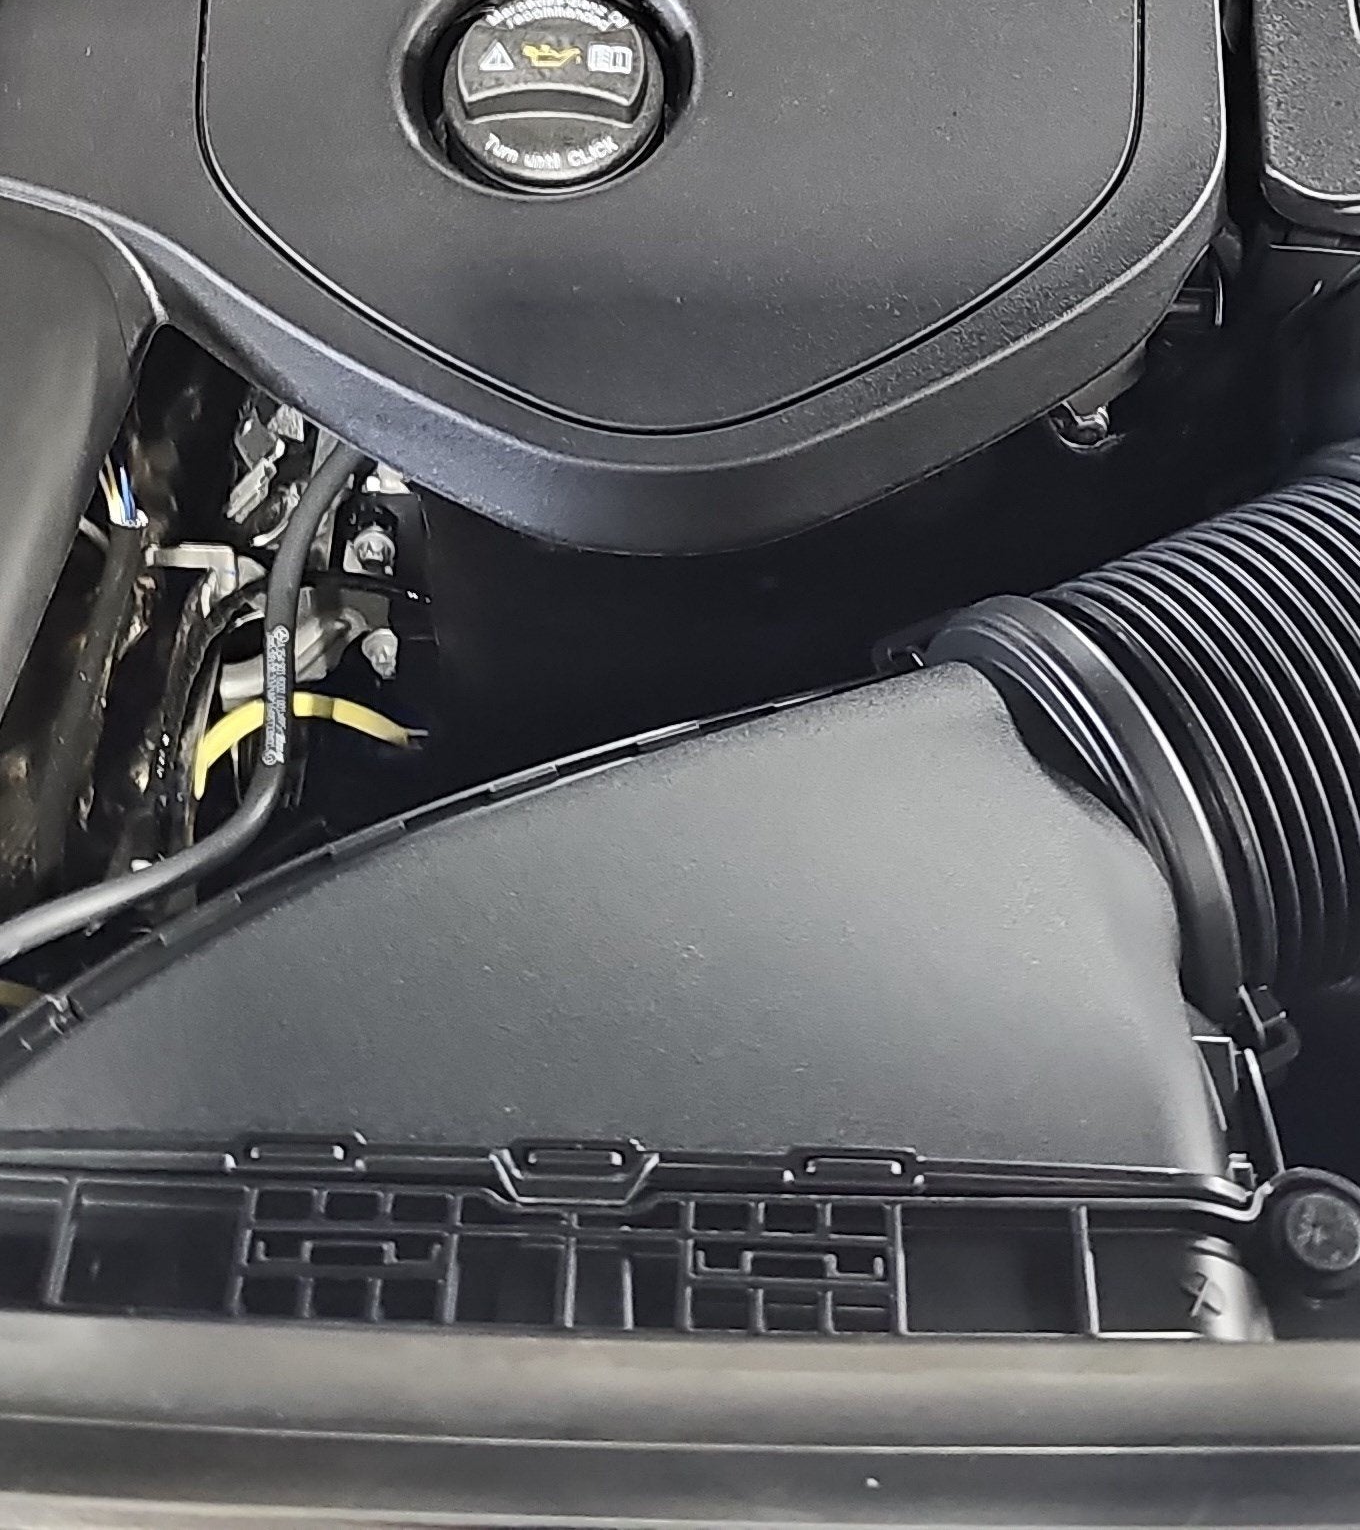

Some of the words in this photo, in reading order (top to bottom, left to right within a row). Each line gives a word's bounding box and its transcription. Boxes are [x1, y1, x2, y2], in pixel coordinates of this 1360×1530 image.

[484, 132, 519, 164] Turn
[523, 151, 561, 169] until
[567, 136, 619, 167] CLICK
